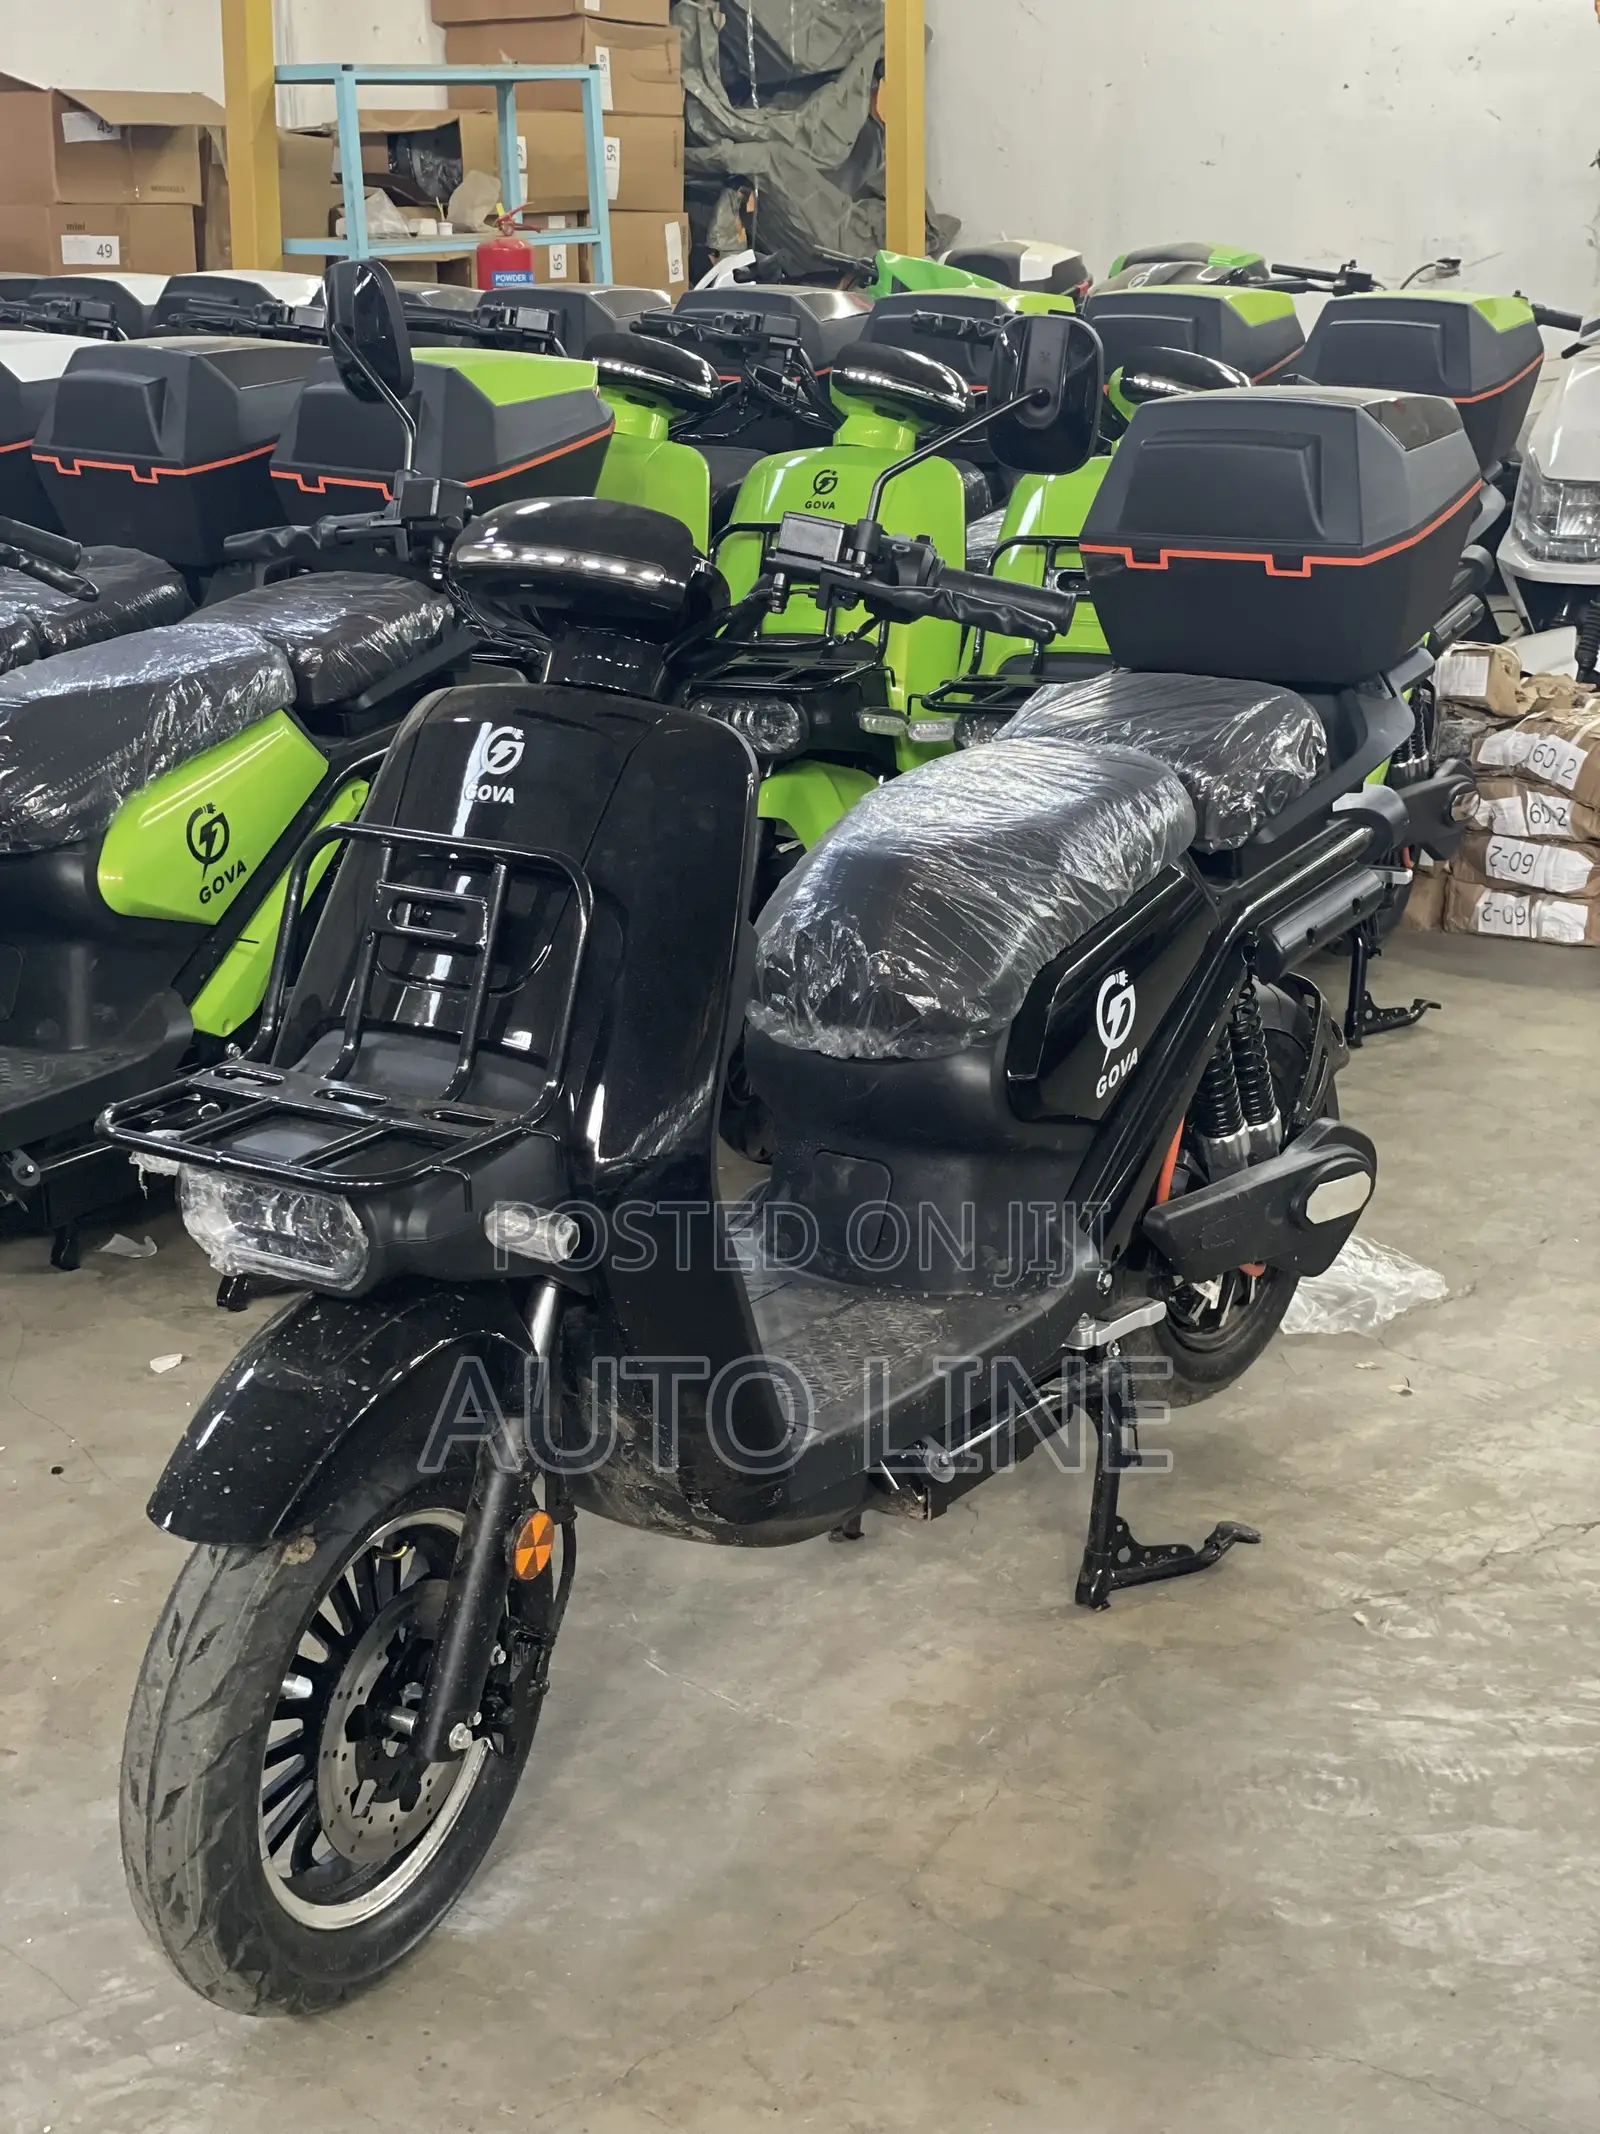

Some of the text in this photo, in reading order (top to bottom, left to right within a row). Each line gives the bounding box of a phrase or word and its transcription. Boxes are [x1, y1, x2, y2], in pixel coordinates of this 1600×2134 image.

[96, 243, 113, 258] 49
[495, 274, 527, 282] POWDER
[804, 500, 836, 510] GOVA
[464, 784, 515, 804] GOVA
[199, 859, 247, 905] GOVA
[1095, 1046, 1138, 1099] GOVA
